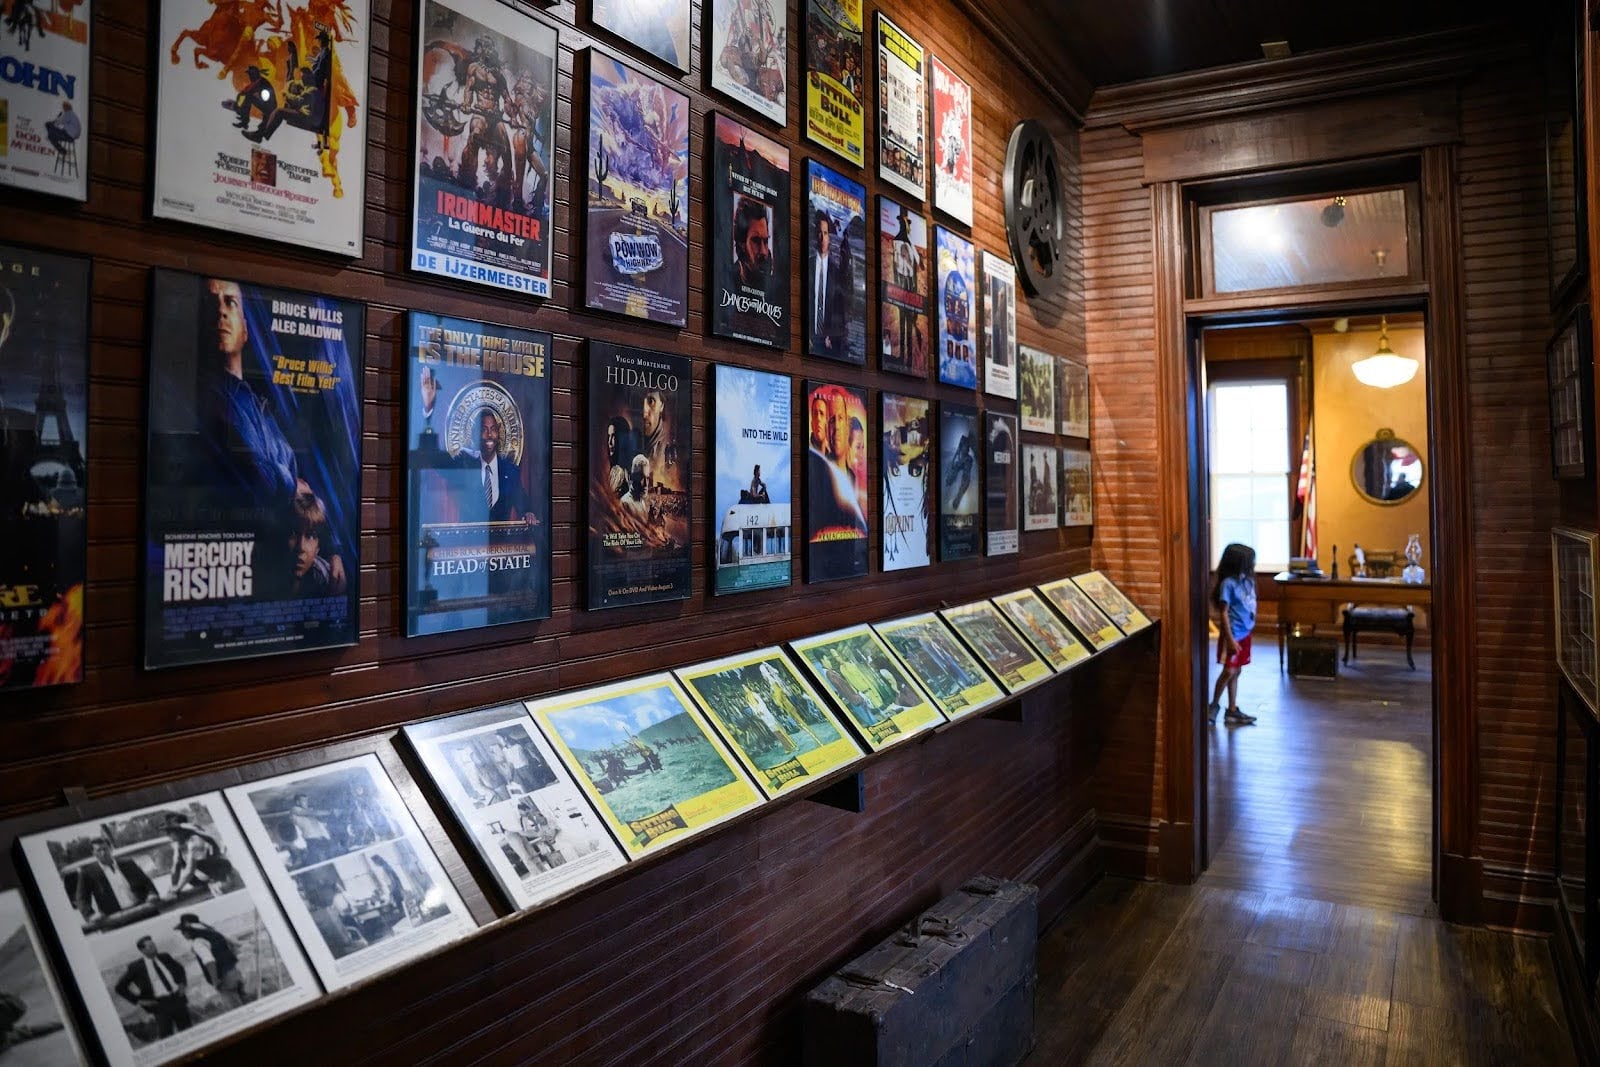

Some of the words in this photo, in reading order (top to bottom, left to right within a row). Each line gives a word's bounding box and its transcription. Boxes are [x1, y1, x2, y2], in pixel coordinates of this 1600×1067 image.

[810, 71, 860, 115] SITTING
[821, 93, 852, 126] BULL
[437, 190, 541, 241] IRONMASTER
[448, 217, 460, 230] La
[461, 221, 495, 240] Guerre
[496, 231, 510, 244] du
[509, 234, 525, 247] Fer
[417, 253, 437, 269] DE
[615, 241, 659, 258] POWWOW
[272, 300, 306, 316] BRUCE
[308, 306, 343, 325] WILLIS
[720, 288, 750, 312] DANCES
[757, 296, 782, 327] WOLVES
[271, 318, 297, 335] ALEC
[298, 323, 343, 341] BALDWIN
[418, 325, 442, 341] THE
[443, 329, 473, 347] ONLY
[475, 334, 510, 350] THING
[511, 339, 545, 356] WHITE
[418, 341, 441, 365] IS
[444, 344, 481, 369] THE
[482, 350, 545, 378] HOUSE
[272, 371, 295, 385] Best
[296, 372, 315, 387] Film
[606, 366, 678, 392] HIDALGO
[464, 388, 495, 407] STATES
[742, 428, 757, 439] INTO
[758, 429, 772, 440] THE
[772, 431, 788, 441] WILD
[746, 515, 759, 527] 142
[164, 541, 255, 568] MERCURY
[433, 558, 478, 576] HEAD
[479, 557, 488, 573] of
[489, 554, 531, 571] STATE
[163, 565, 253, 602] RISING
[630, 809, 679, 832] SITTING
[645, 820, 678, 839] BULL
